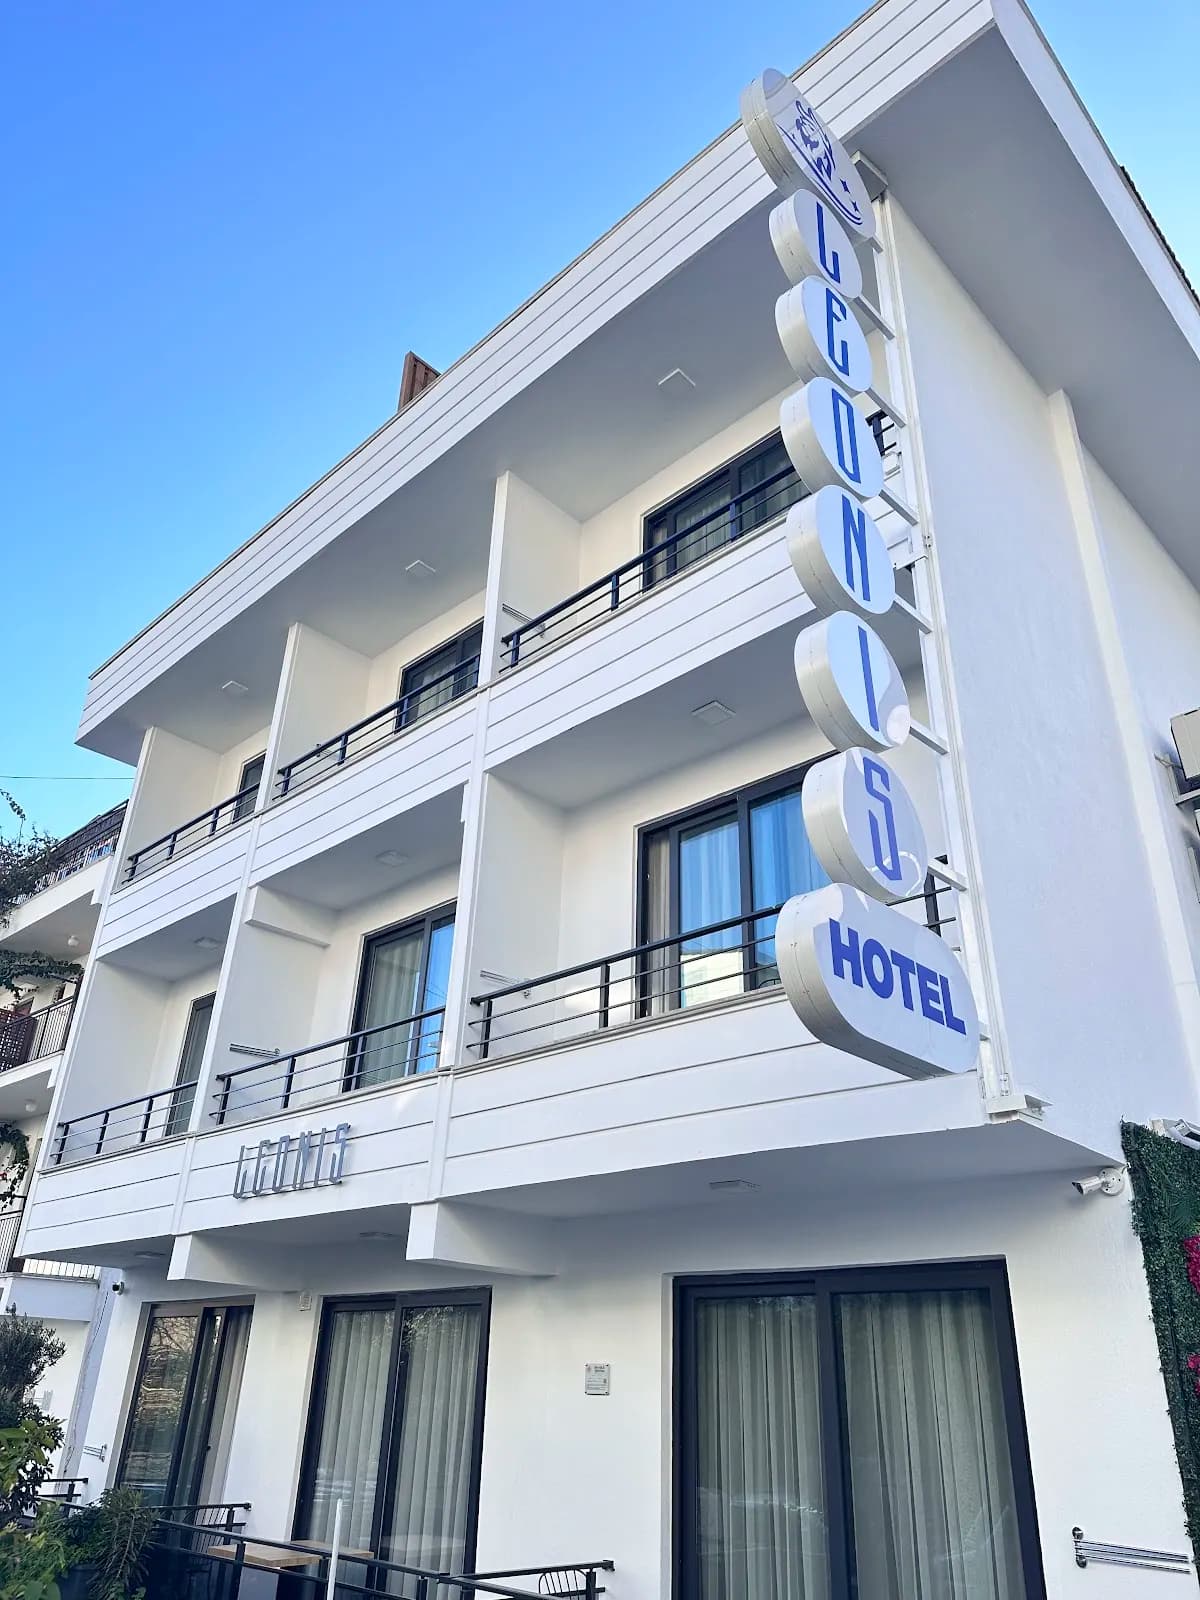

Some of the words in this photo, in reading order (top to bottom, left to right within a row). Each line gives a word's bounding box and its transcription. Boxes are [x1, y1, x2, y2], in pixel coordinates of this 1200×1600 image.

[816, 204, 902, 881] LEONIS
[829, 917, 967, 1035] HOTEL
[233, 1122, 350, 1199] LEONIS
